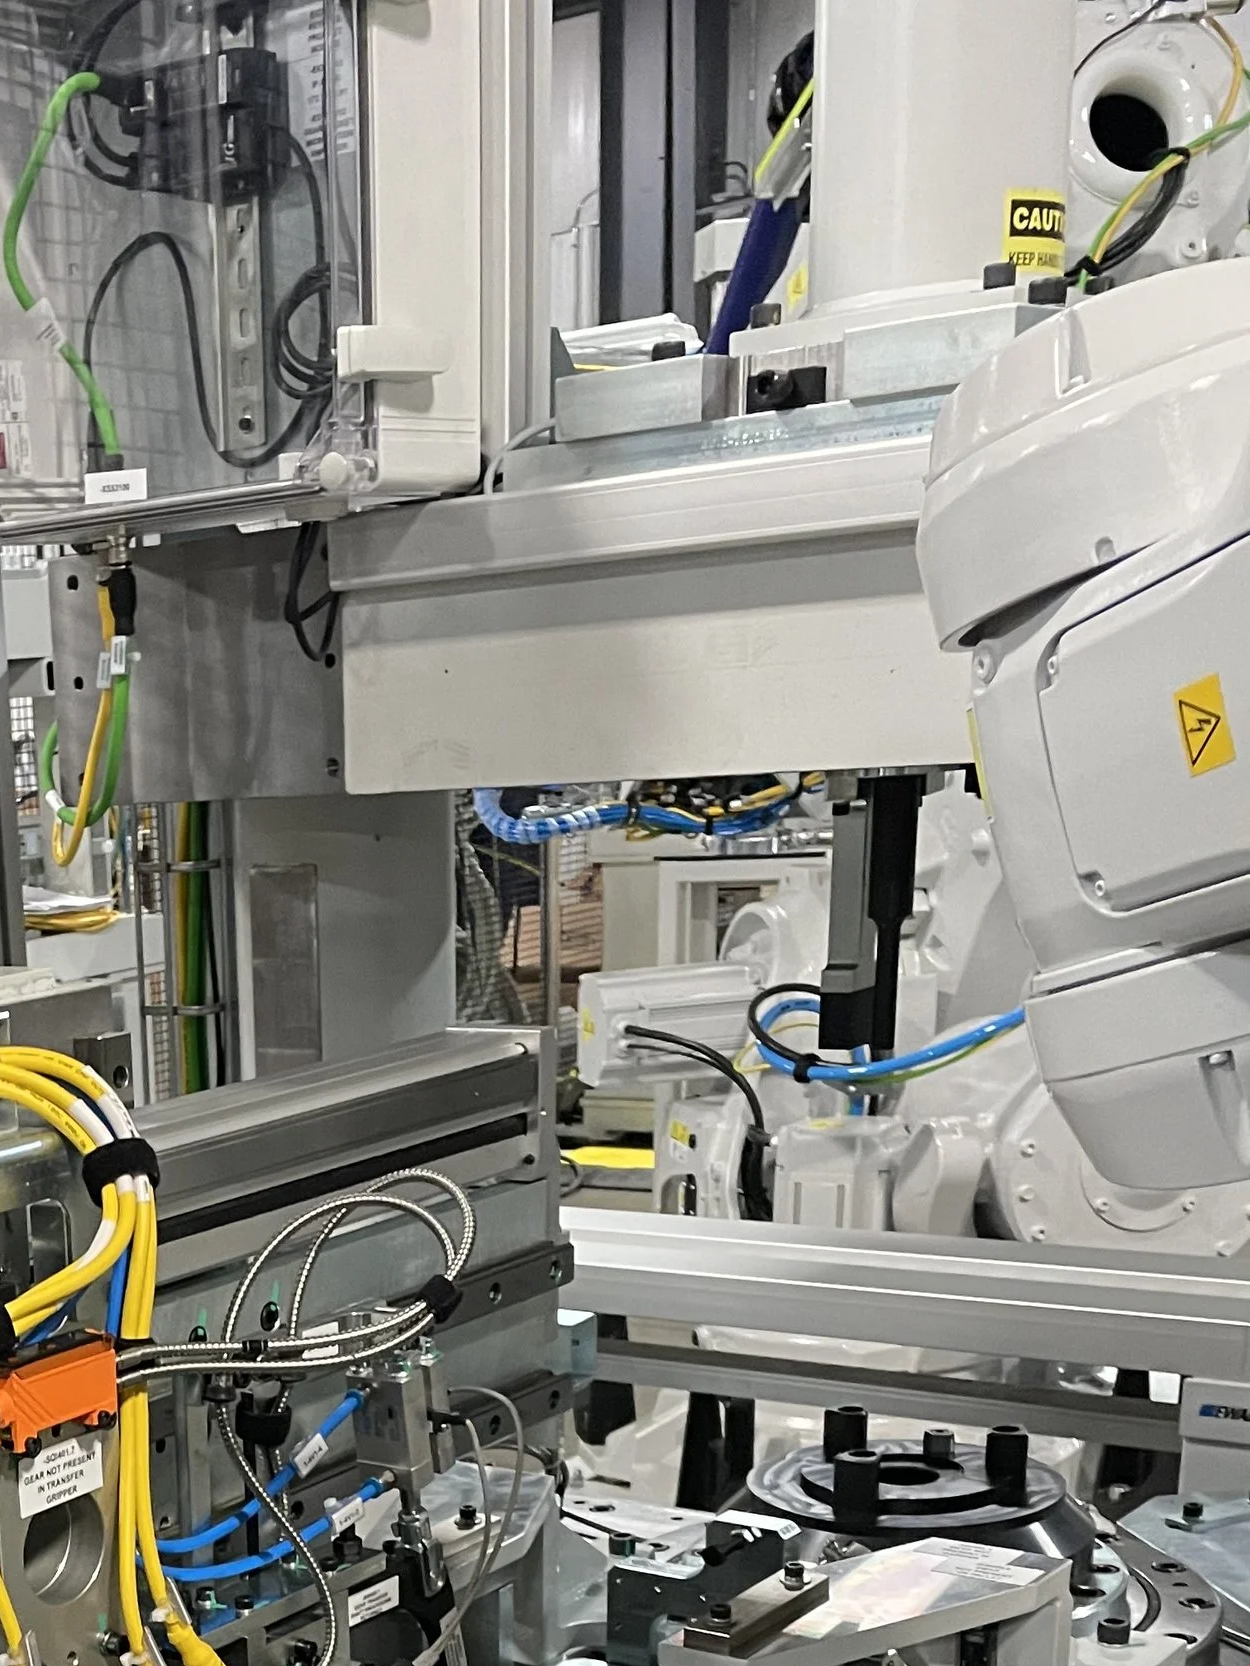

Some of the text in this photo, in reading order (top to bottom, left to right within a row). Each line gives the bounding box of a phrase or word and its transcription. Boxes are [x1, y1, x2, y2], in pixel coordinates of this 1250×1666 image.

[1008, 251, 1036, 266] KEEP
[23, 1451, 96, 1486] GEAR NOT PRESENT
[37, 1469, 84, 1494] IN TRANSFER
[45, 1485, 78, 1504] GRIPPER
